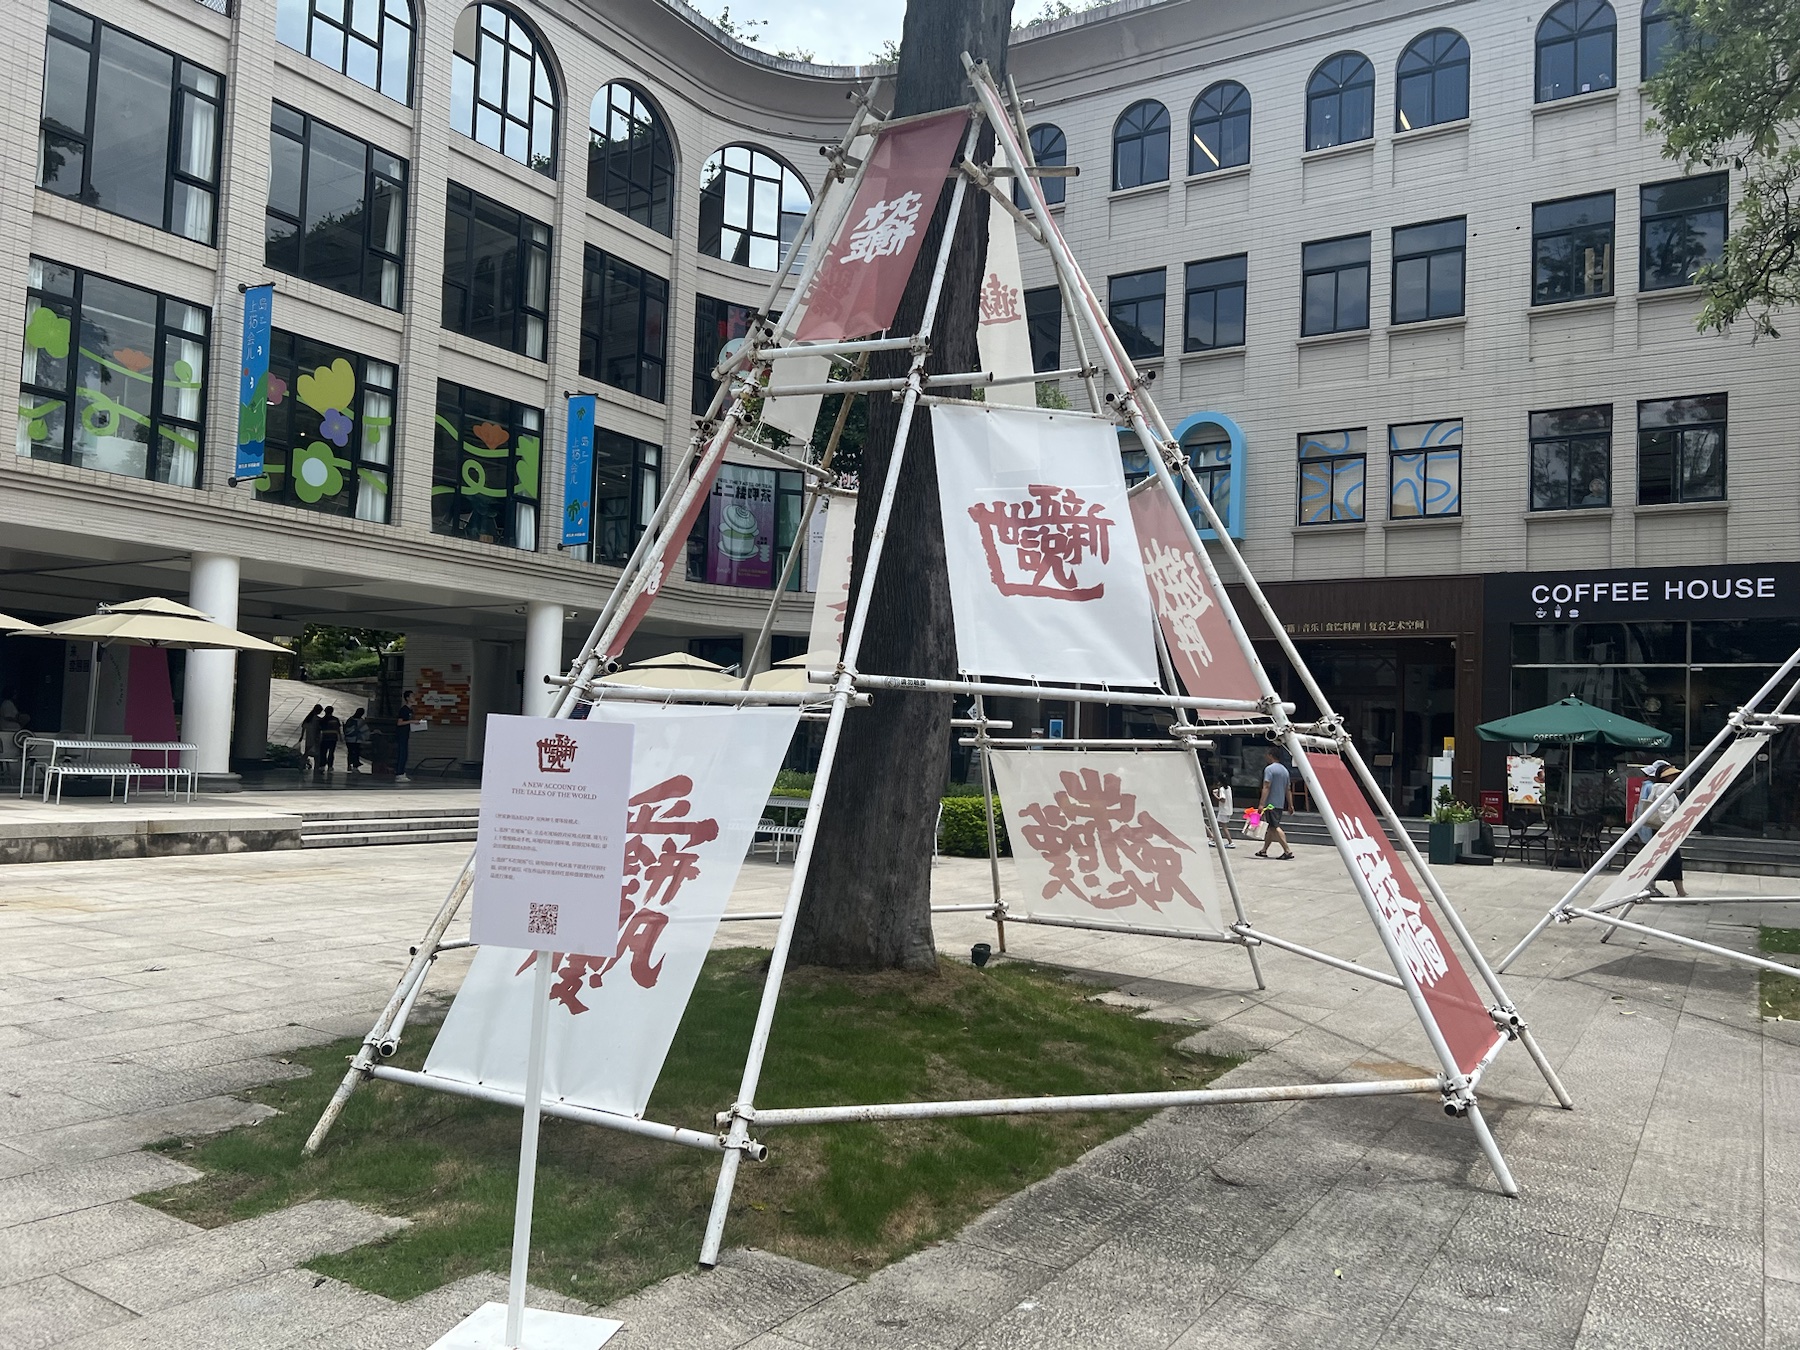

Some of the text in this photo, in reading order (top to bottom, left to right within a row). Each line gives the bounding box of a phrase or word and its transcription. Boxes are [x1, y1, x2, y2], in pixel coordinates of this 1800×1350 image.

[1531, 578, 1776, 604] COFFEE HOUSE
[1533, 733, 1563, 741] COFFEE
[544, 783, 576, 791] ACCOUNT
[572, 792, 597, 800] WORLD
